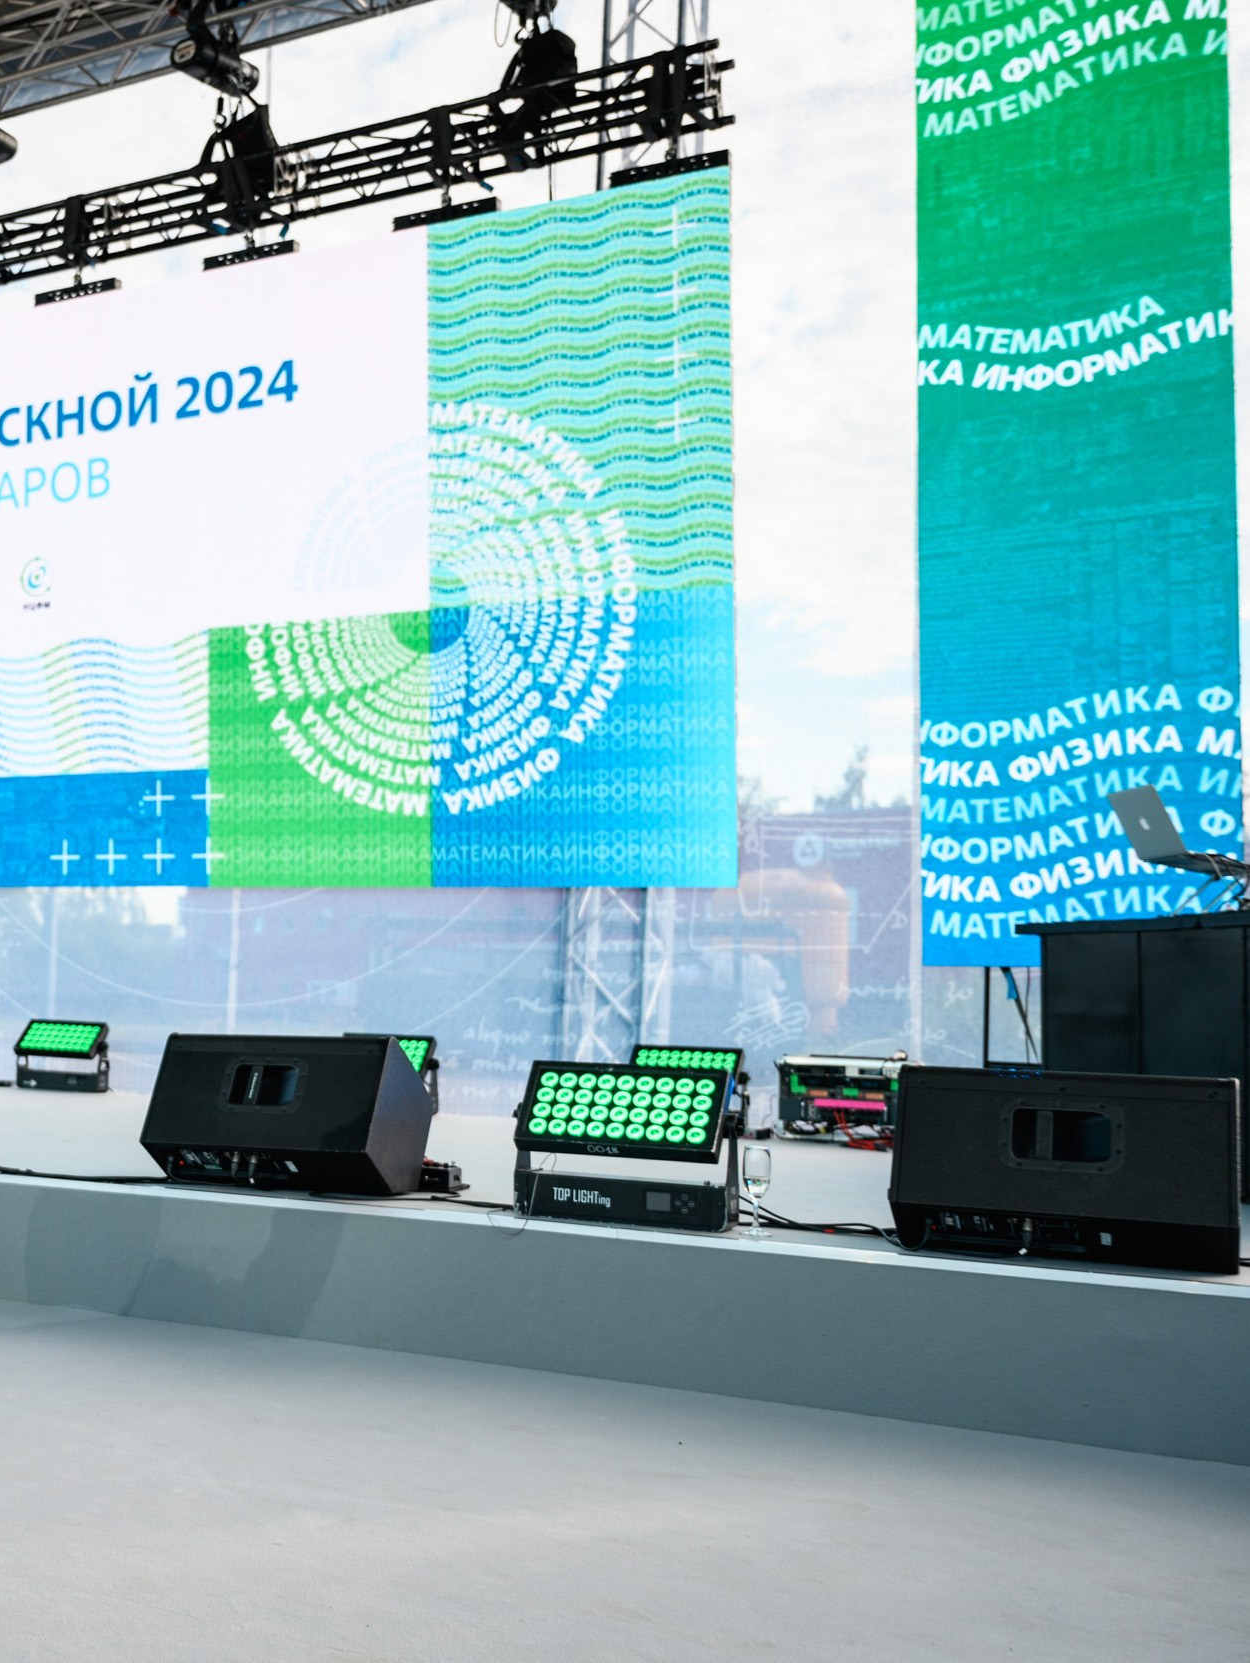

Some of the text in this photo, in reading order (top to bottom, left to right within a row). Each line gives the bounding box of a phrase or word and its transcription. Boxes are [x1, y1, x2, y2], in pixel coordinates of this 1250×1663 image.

[917, 0, 1026, 31] МАТЕ
[1001, 0, 1171, 83] ФИЗИКА
[923, 32, 1188, 138] МАТЕМАТИКА
[918, 296, 1165, 354] МАТЕМАТИКА
[175, 359, 300, 420] 2024
[431, 402, 602, 500] МАТЕМАТИКА
[461, 689, 543, 754] ФИЗИКА
[1197, 685, 1240, 717] Ф
[270, 707, 428, 817] МАТЕМАТИКА
[301, 703, 441, 786] МАТЕМАТИКА
[453, 715, 551, 782] ФИЗИКА
[1008, 725, 1183, 782] ФИЗИКА
[1196, 726, 1241, 760] М
[442, 747, 561, 815] ФИЗИКА
[921, 765, 1183, 824] МАТЕМАТИКА
[553, 1187, 611, 1208] TOP LIGHTing
